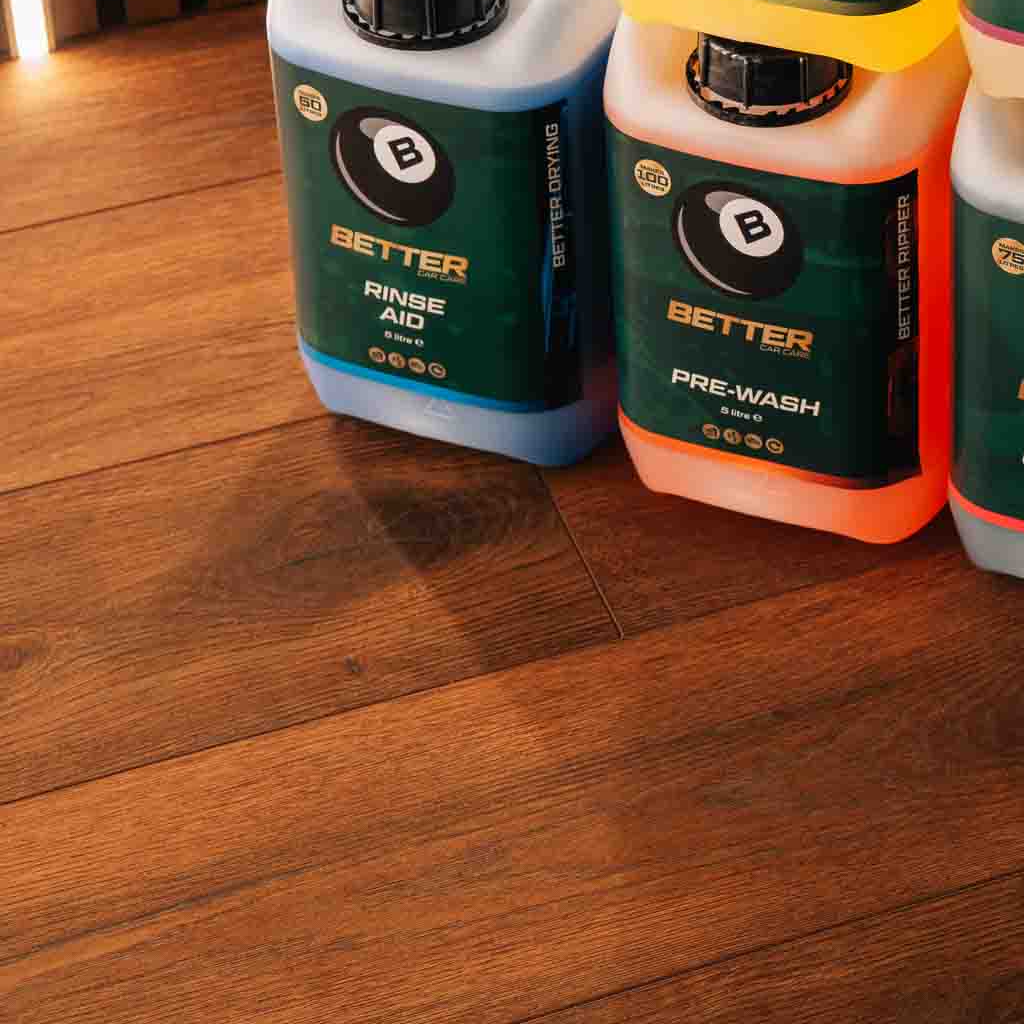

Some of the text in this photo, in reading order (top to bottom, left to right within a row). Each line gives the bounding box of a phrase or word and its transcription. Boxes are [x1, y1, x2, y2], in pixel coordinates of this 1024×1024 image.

[388, 137, 423, 170] B
[637, 168, 669, 186] 100
[545, 122, 565, 267] BETTER DRYING
[734, 210, 772, 244] B
[330, 223, 469, 278] BETTER
[897, 194, 911, 339] BETTER RIPPER
[998, 247, 1024, 265] 75
[364, 280, 447, 315] RINSE
[379, 306, 424, 330] AID
[667, 299, 814, 351] BETTER
[759, 343, 781, 355] CAR
[671, 368, 821, 417] PRE-WASH
[720, 406, 730, 415] 5
[731, 408, 750, 420] litre
